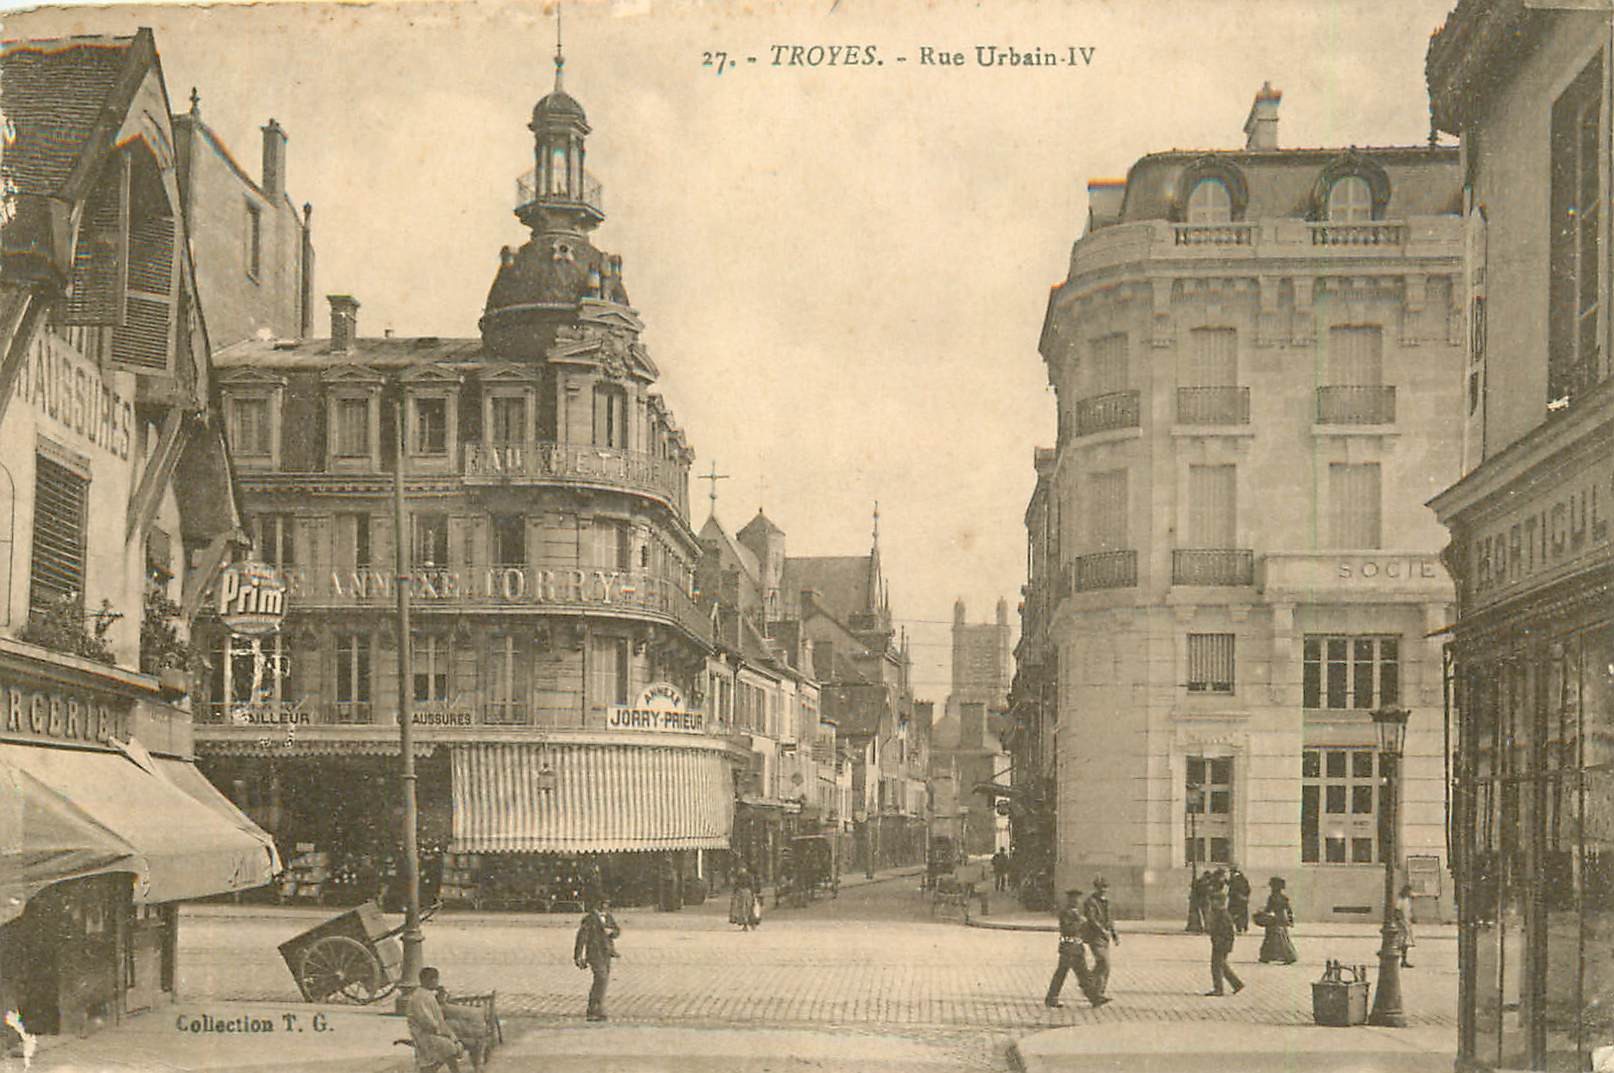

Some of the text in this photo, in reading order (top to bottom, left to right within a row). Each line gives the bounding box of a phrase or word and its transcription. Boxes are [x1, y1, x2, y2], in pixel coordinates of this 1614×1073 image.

[17, 338, 131, 462] HAUSSURES
[1477, 470, 1614, 590] HORTICUL
[220, 567, 288, 615] Prim
[329, 571, 460, 599] ANNXE
[238, 712, 310, 725] AILLEUR
[396, 712, 472, 726] CAUSSURES
